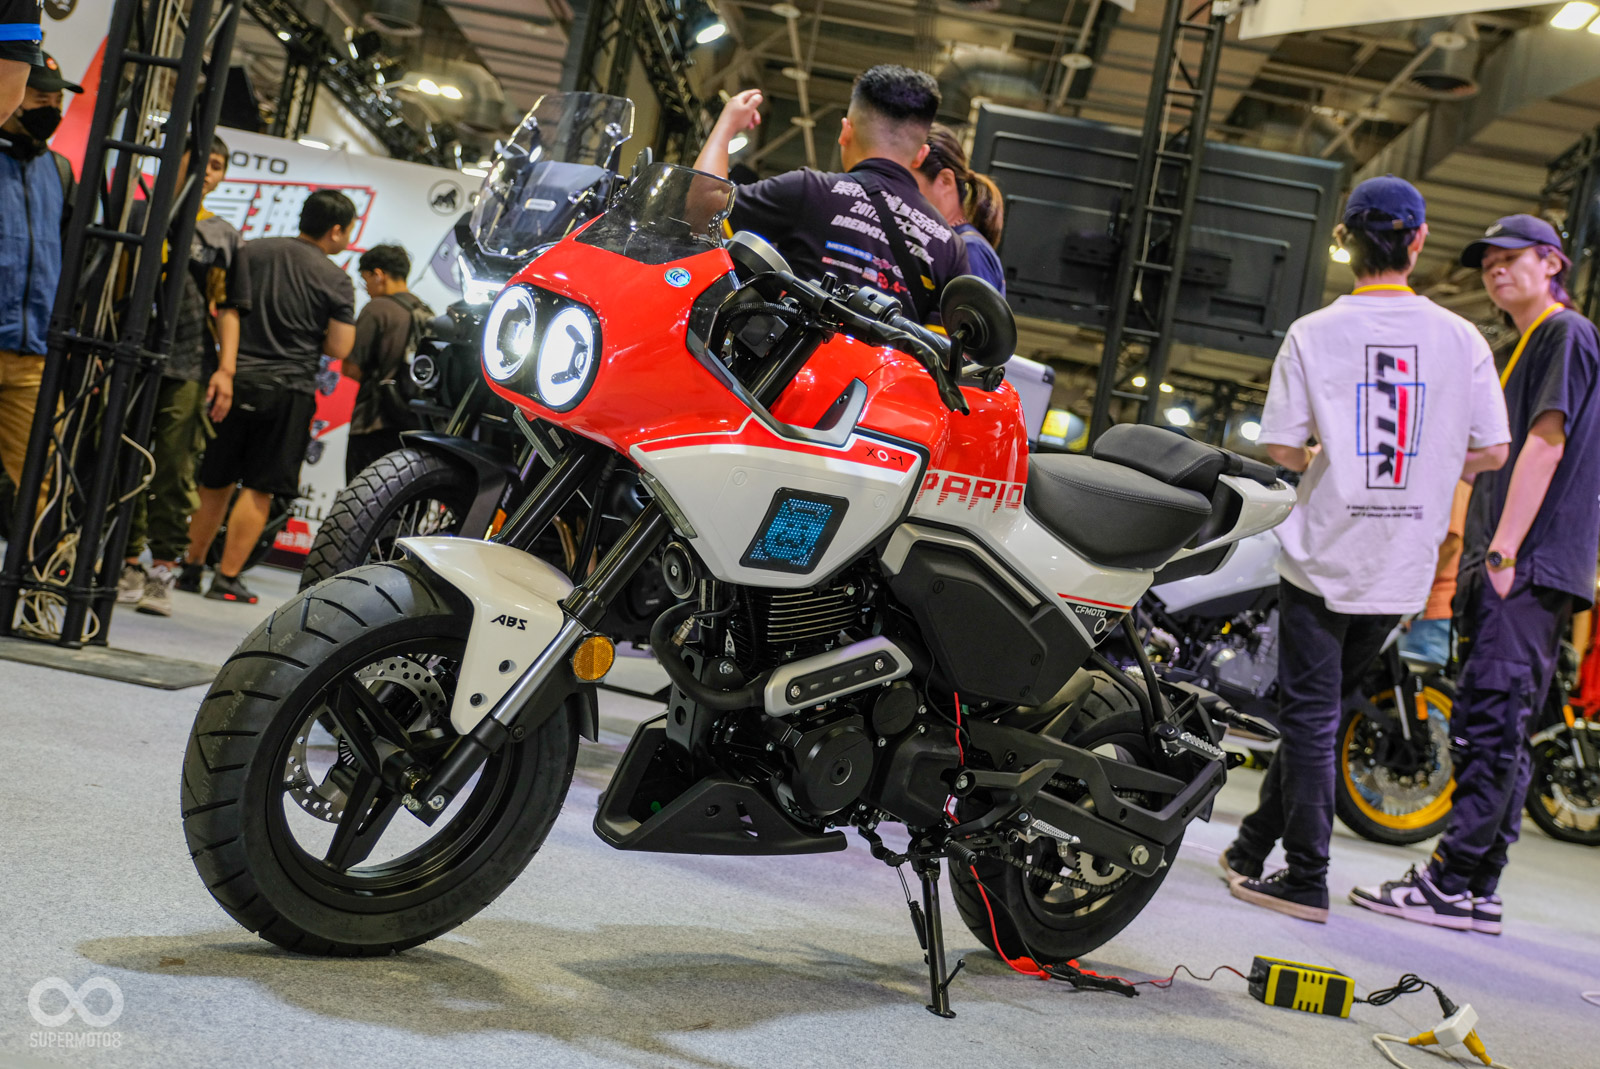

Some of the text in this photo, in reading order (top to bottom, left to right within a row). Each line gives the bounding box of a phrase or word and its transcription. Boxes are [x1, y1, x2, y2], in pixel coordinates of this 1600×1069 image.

[231, 151, 288, 174] OTO
[914, 472, 1024, 513] PAPIO
[1075, 605, 1107, 618] CFMOTO
[490, 614, 528, 631] ABS
